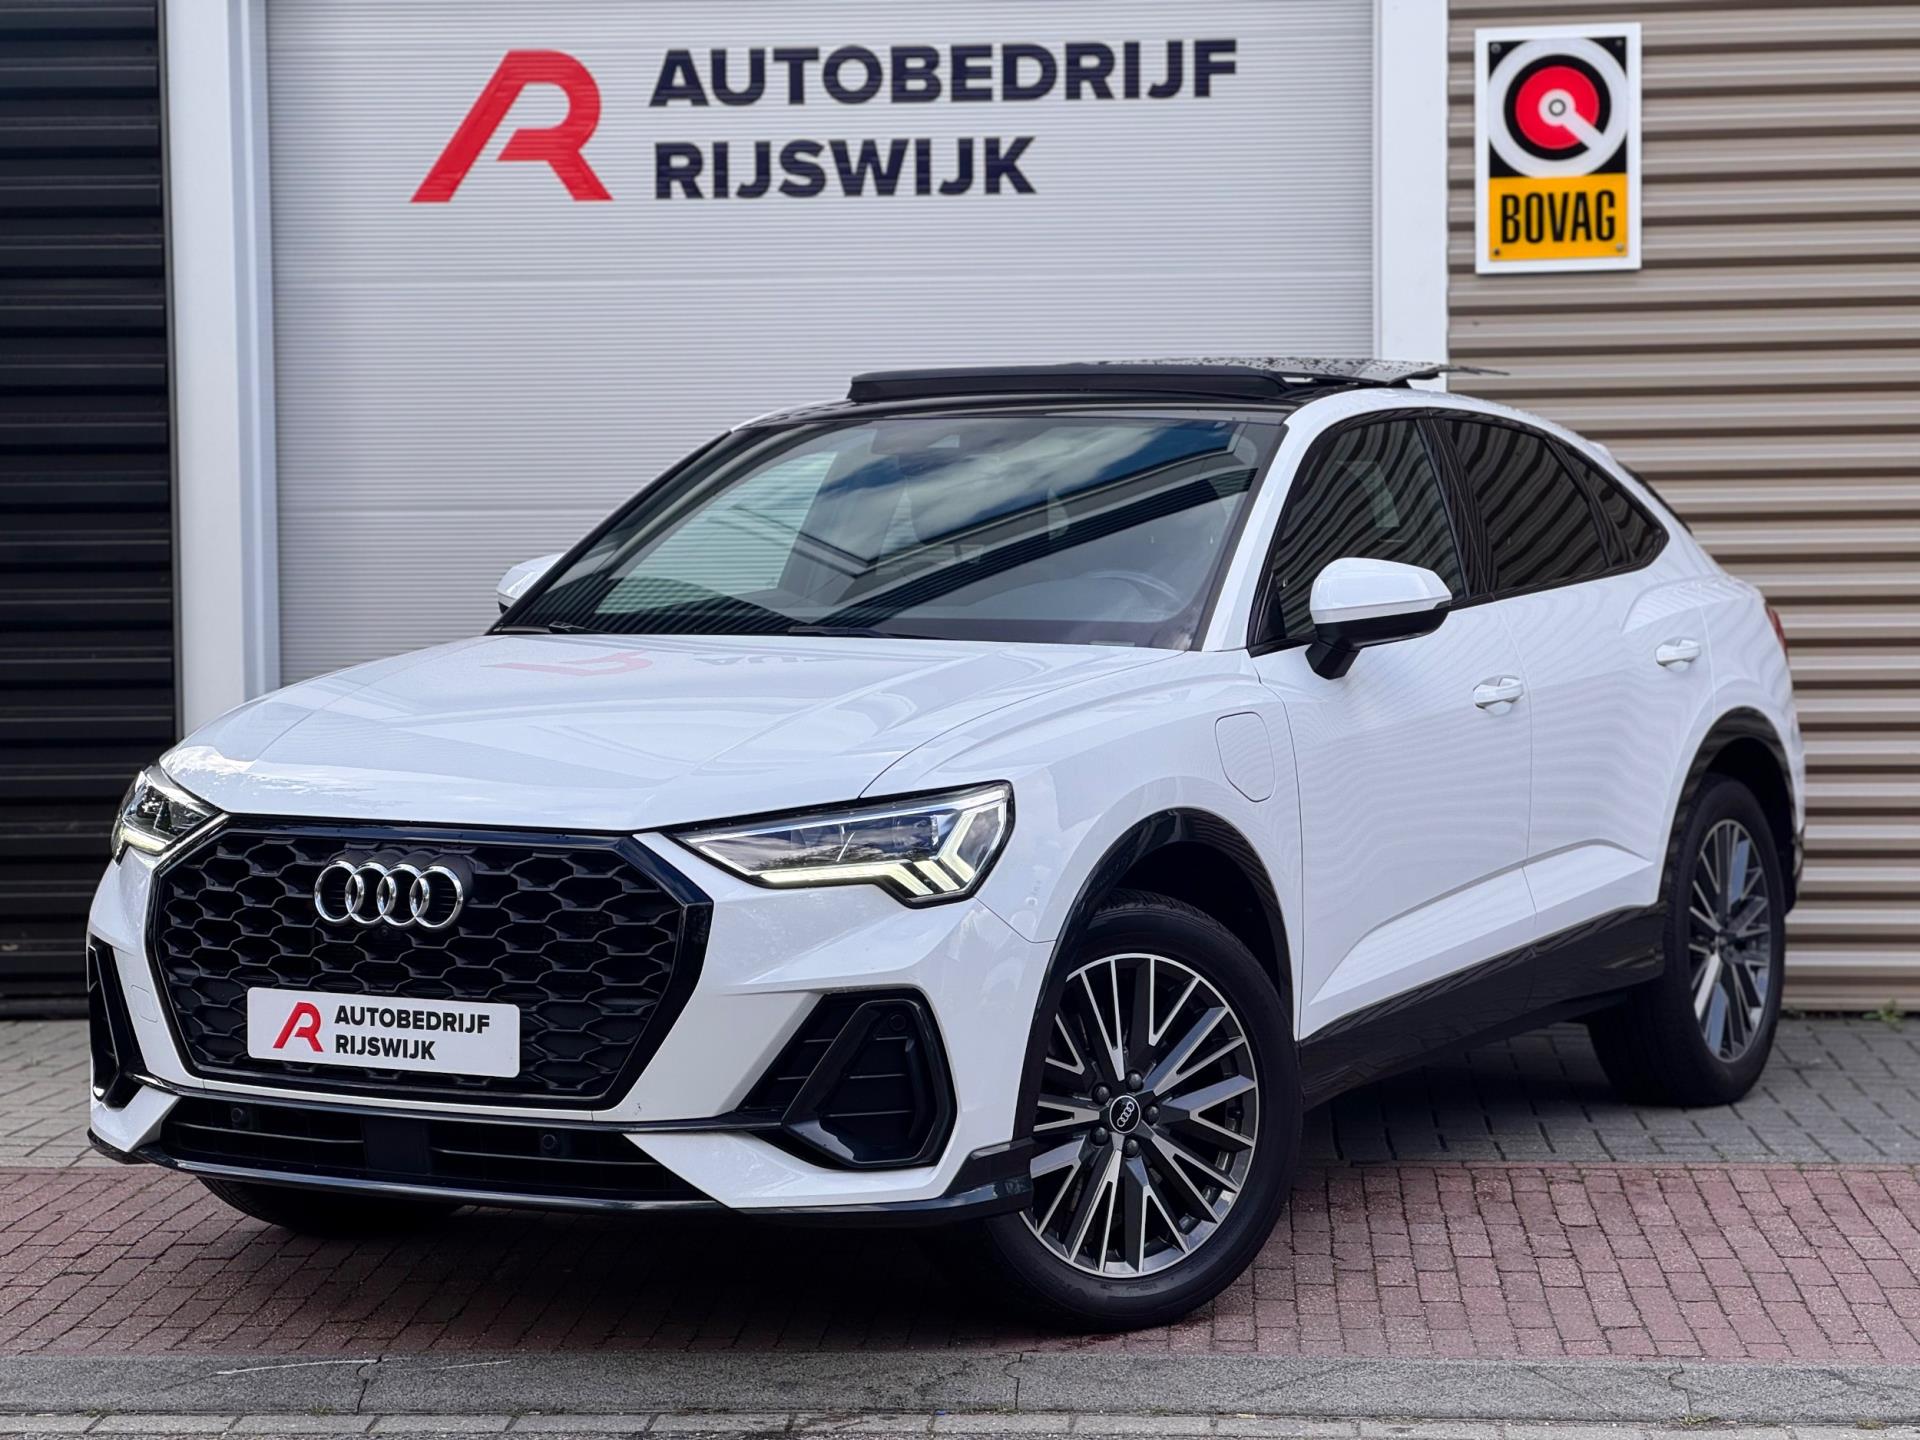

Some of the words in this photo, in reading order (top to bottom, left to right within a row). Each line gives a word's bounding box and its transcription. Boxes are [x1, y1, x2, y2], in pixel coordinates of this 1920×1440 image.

[649, 38, 1238, 108] AUTOBEDRIJF
[654, 136, 1037, 200] RIJSWIJK
[1501, 189, 1616, 244] BOVAG
[334, 1005, 490, 1034] AUTOBEDRIJF
[335, 1034, 436, 1061] RIJSWIJK
